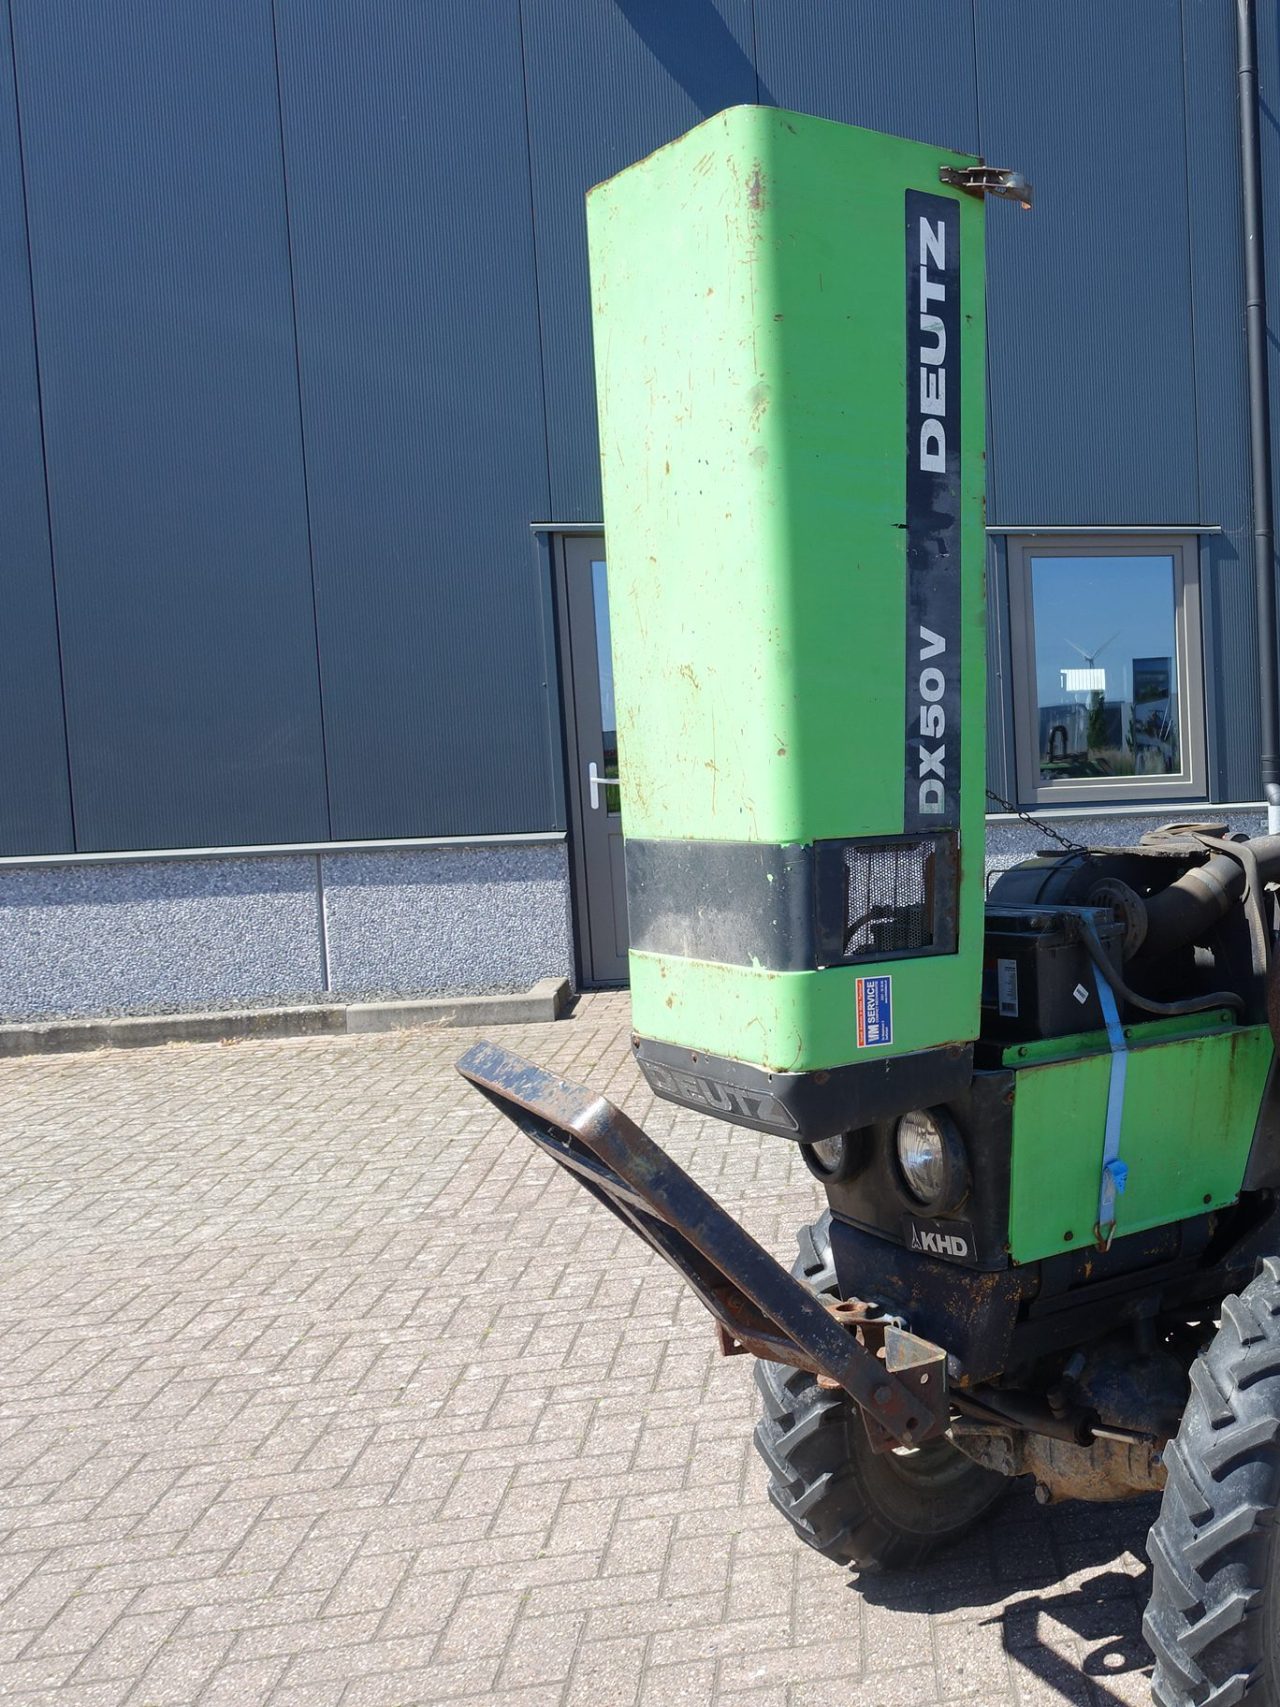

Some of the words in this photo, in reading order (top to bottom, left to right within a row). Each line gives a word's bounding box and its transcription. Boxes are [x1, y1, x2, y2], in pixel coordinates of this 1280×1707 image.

[920, 216, 946, 474] DEUTZ
[867, 980, 876, 1024] SERVICE
[645, 1061, 793, 1126] DEUTZ
[920, 1231, 968, 1257] KHD
